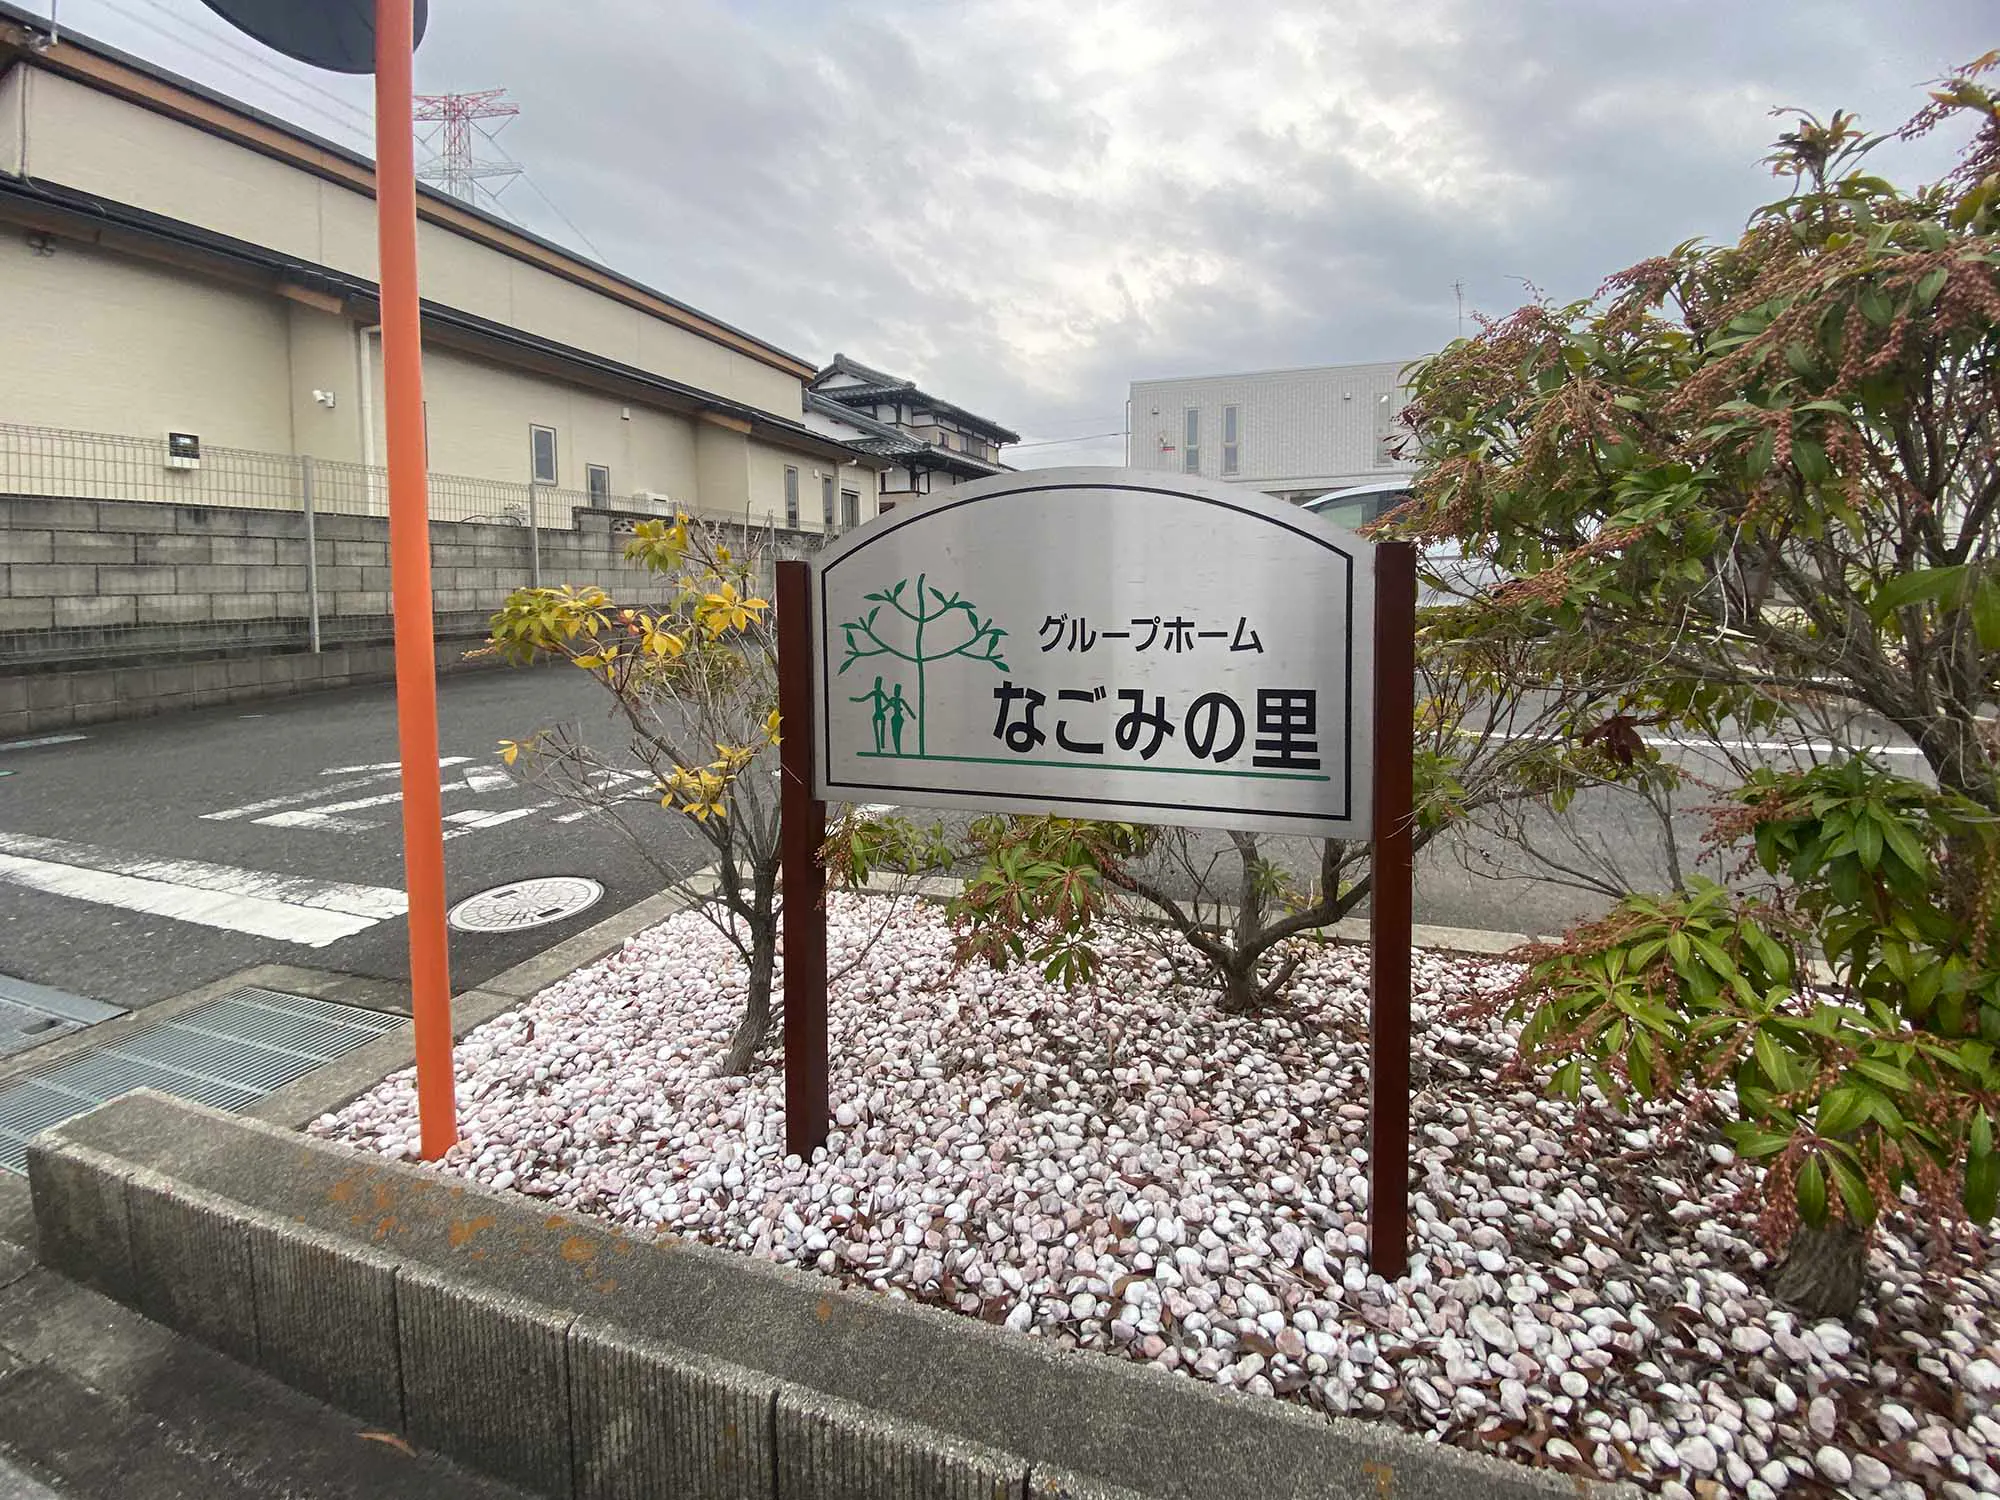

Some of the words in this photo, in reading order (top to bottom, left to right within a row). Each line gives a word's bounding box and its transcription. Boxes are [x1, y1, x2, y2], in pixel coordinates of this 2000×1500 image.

[1038, 613, 1264, 654] グループホーム
[993, 680, 1321, 770] なごみの里
